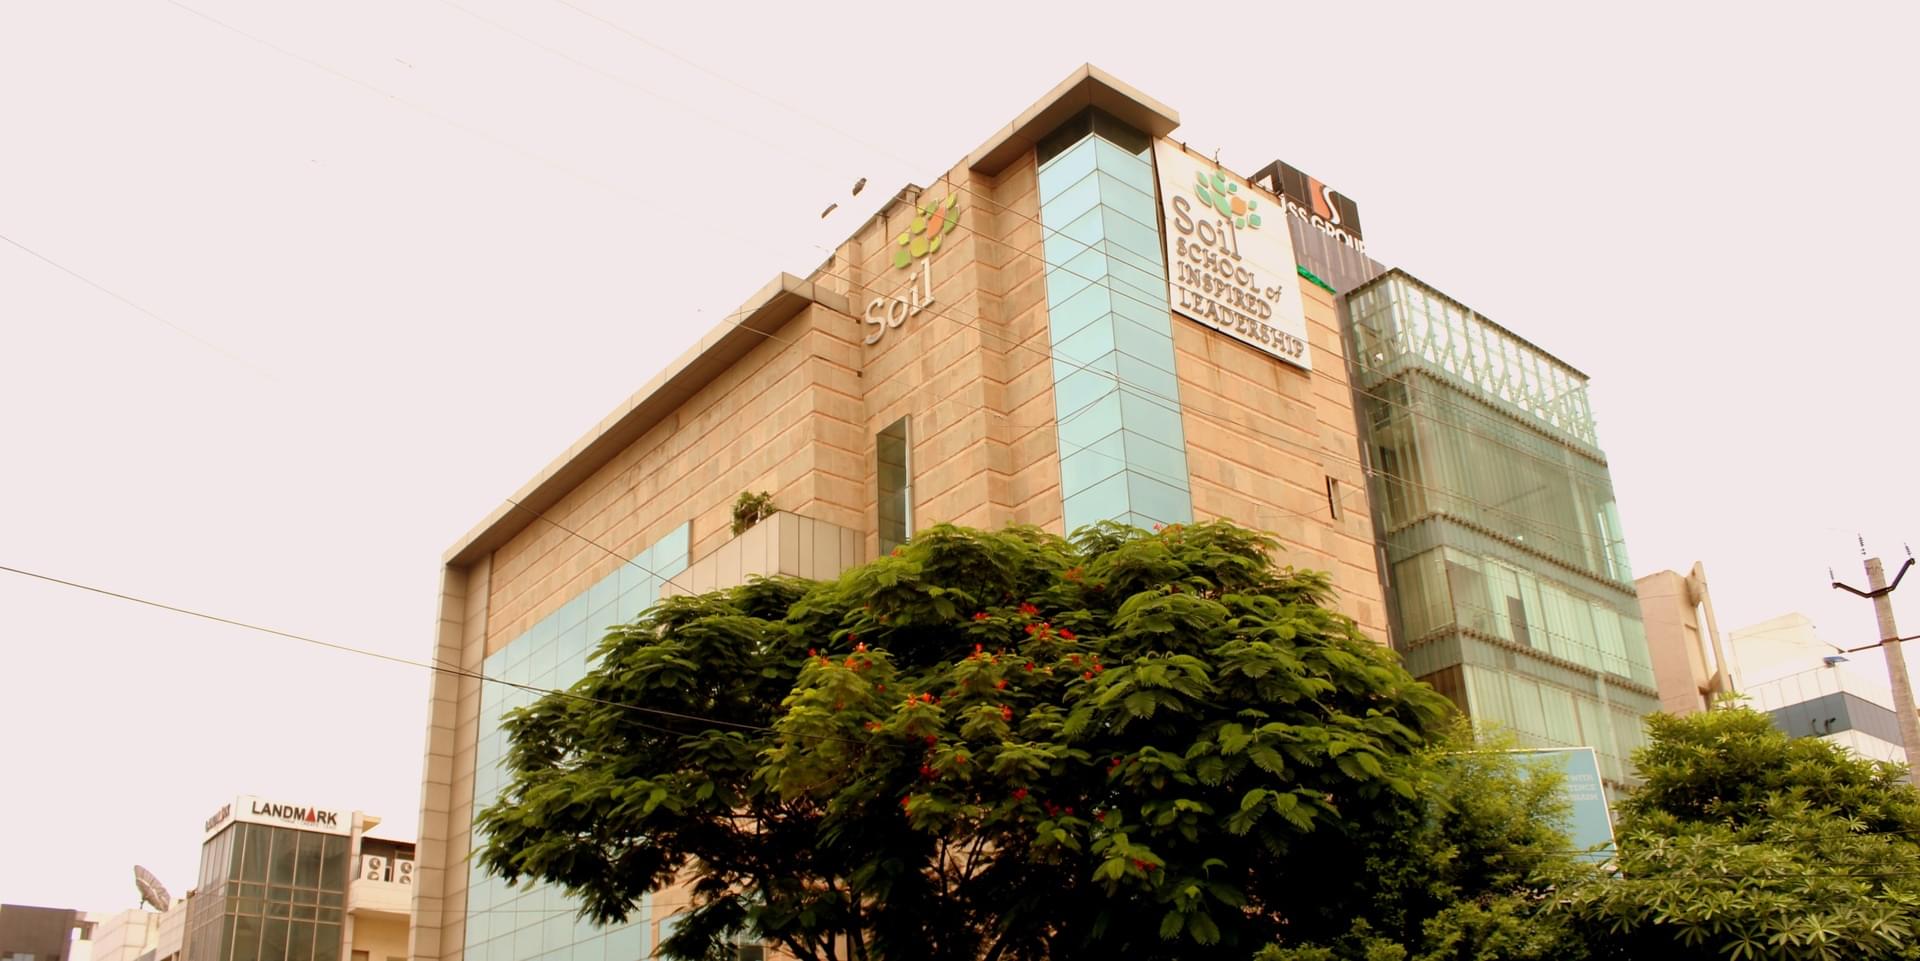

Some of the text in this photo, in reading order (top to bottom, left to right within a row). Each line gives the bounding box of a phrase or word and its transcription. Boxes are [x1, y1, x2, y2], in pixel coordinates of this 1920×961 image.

[1172, 196, 1241, 262] Soil
[864, 257, 934, 344] Soil
[1176, 237, 1282, 303] SCHOOL of
[1177, 261, 1272, 320] INSPIRED
[1178, 286, 1304, 358] LEADERSHIP
[251, 801, 337, 825] LANDMARK
